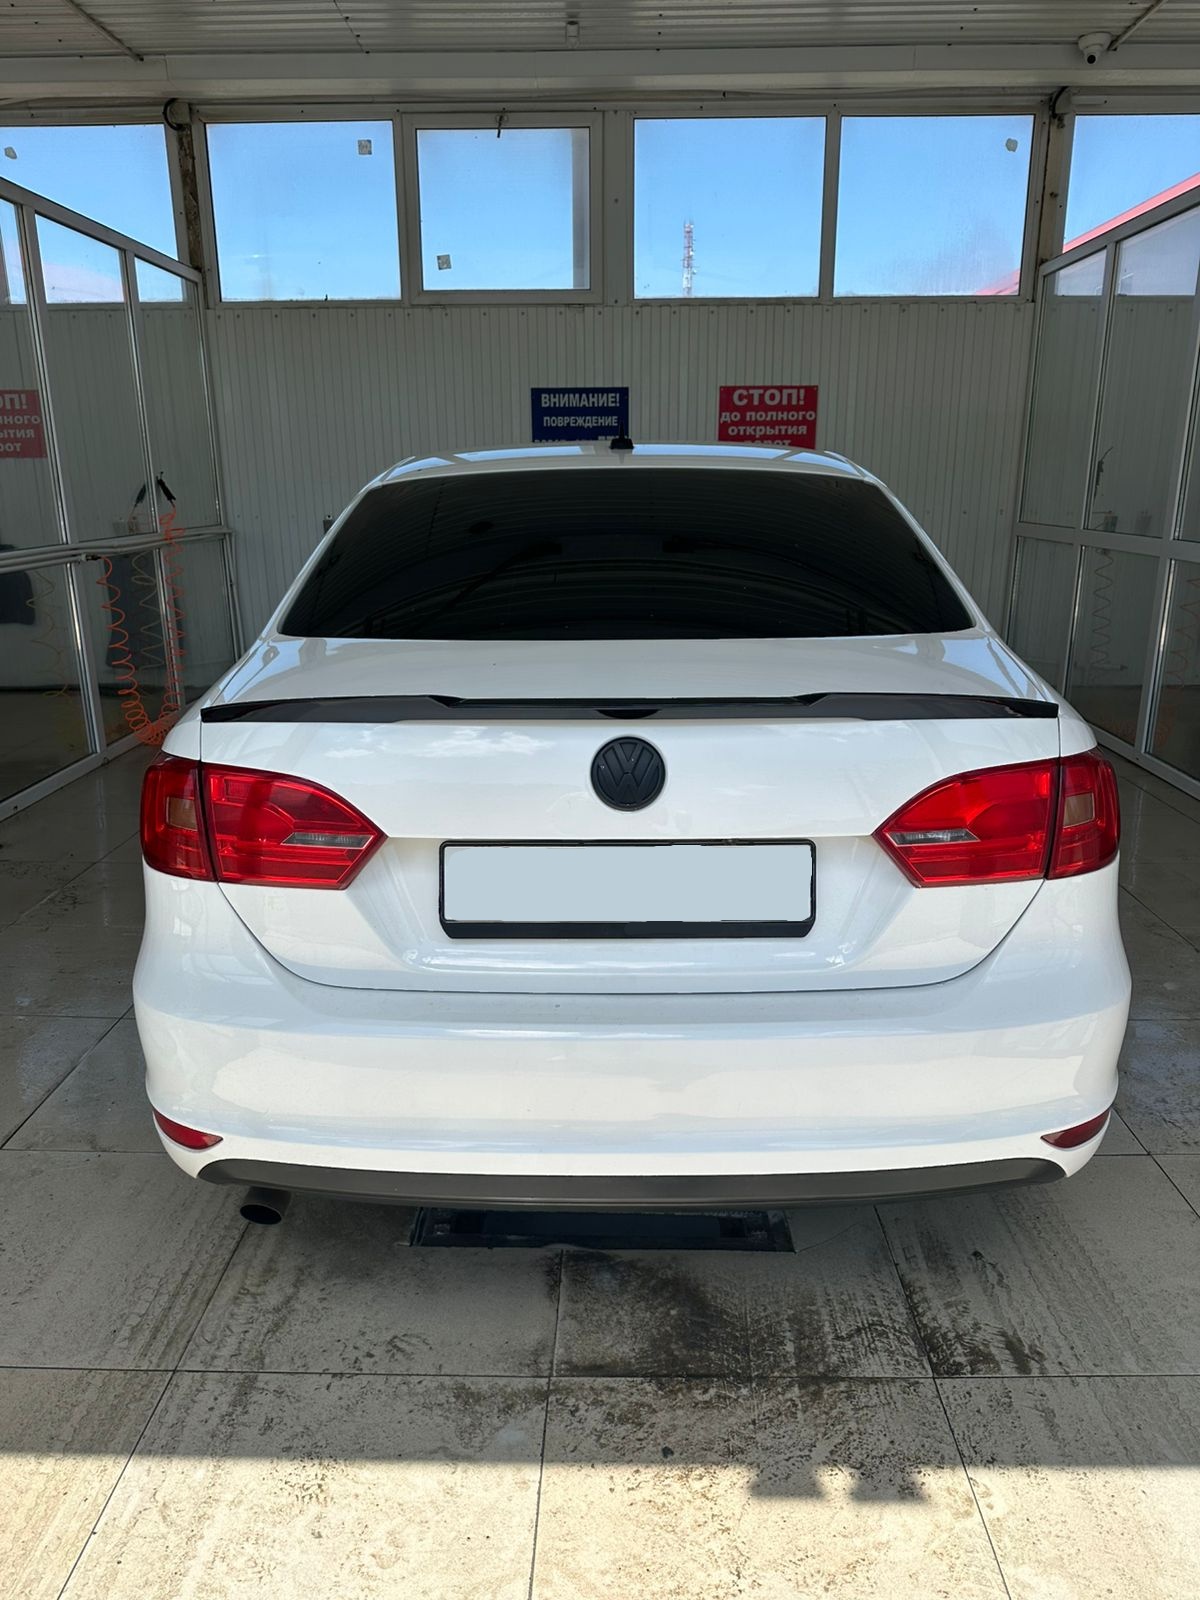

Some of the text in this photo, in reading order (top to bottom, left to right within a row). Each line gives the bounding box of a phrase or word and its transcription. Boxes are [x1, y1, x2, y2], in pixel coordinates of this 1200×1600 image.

[541, 393, 620, 407] ВНИМАНИЕ!
[732, 388, 805, 406] СТОП!
[543, 416, 618, 428] ПОВРЕЖДЕНИЕ
[720, 410, 816, 424] до полного
[728, 425, 808, 438] открытия
